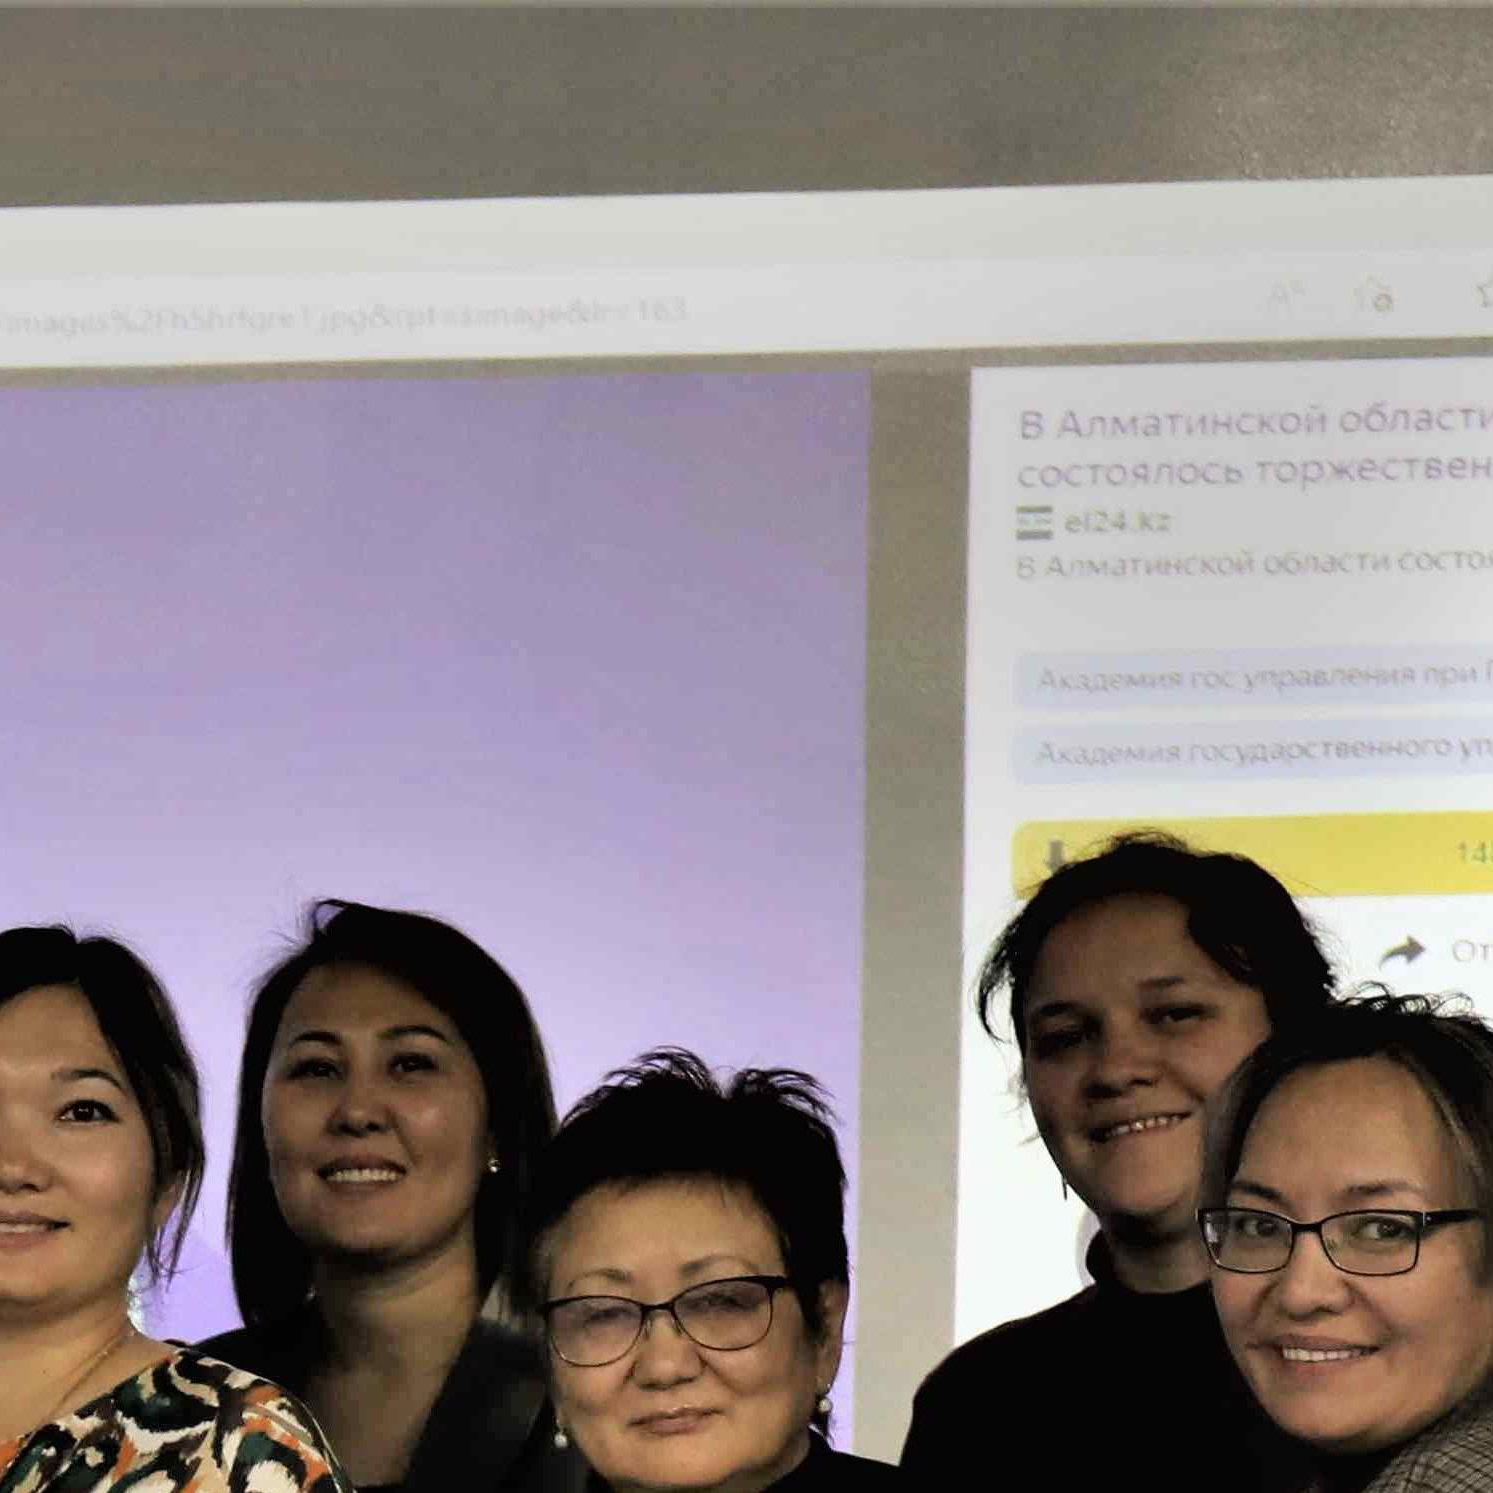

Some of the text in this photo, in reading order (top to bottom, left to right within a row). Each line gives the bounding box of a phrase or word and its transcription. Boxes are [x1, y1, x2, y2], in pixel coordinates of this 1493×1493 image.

[1021, 410, 1044, 440] В
[1057, 402, 1328, 438] Алматинской
[1016, 460, 1244, 489] состоялось
[1045, 550, 1255, 579] Алматинской
[1037, 665, 1477, 696] Академия гос управления при
[1036, 741, 1182, 767] Академия
